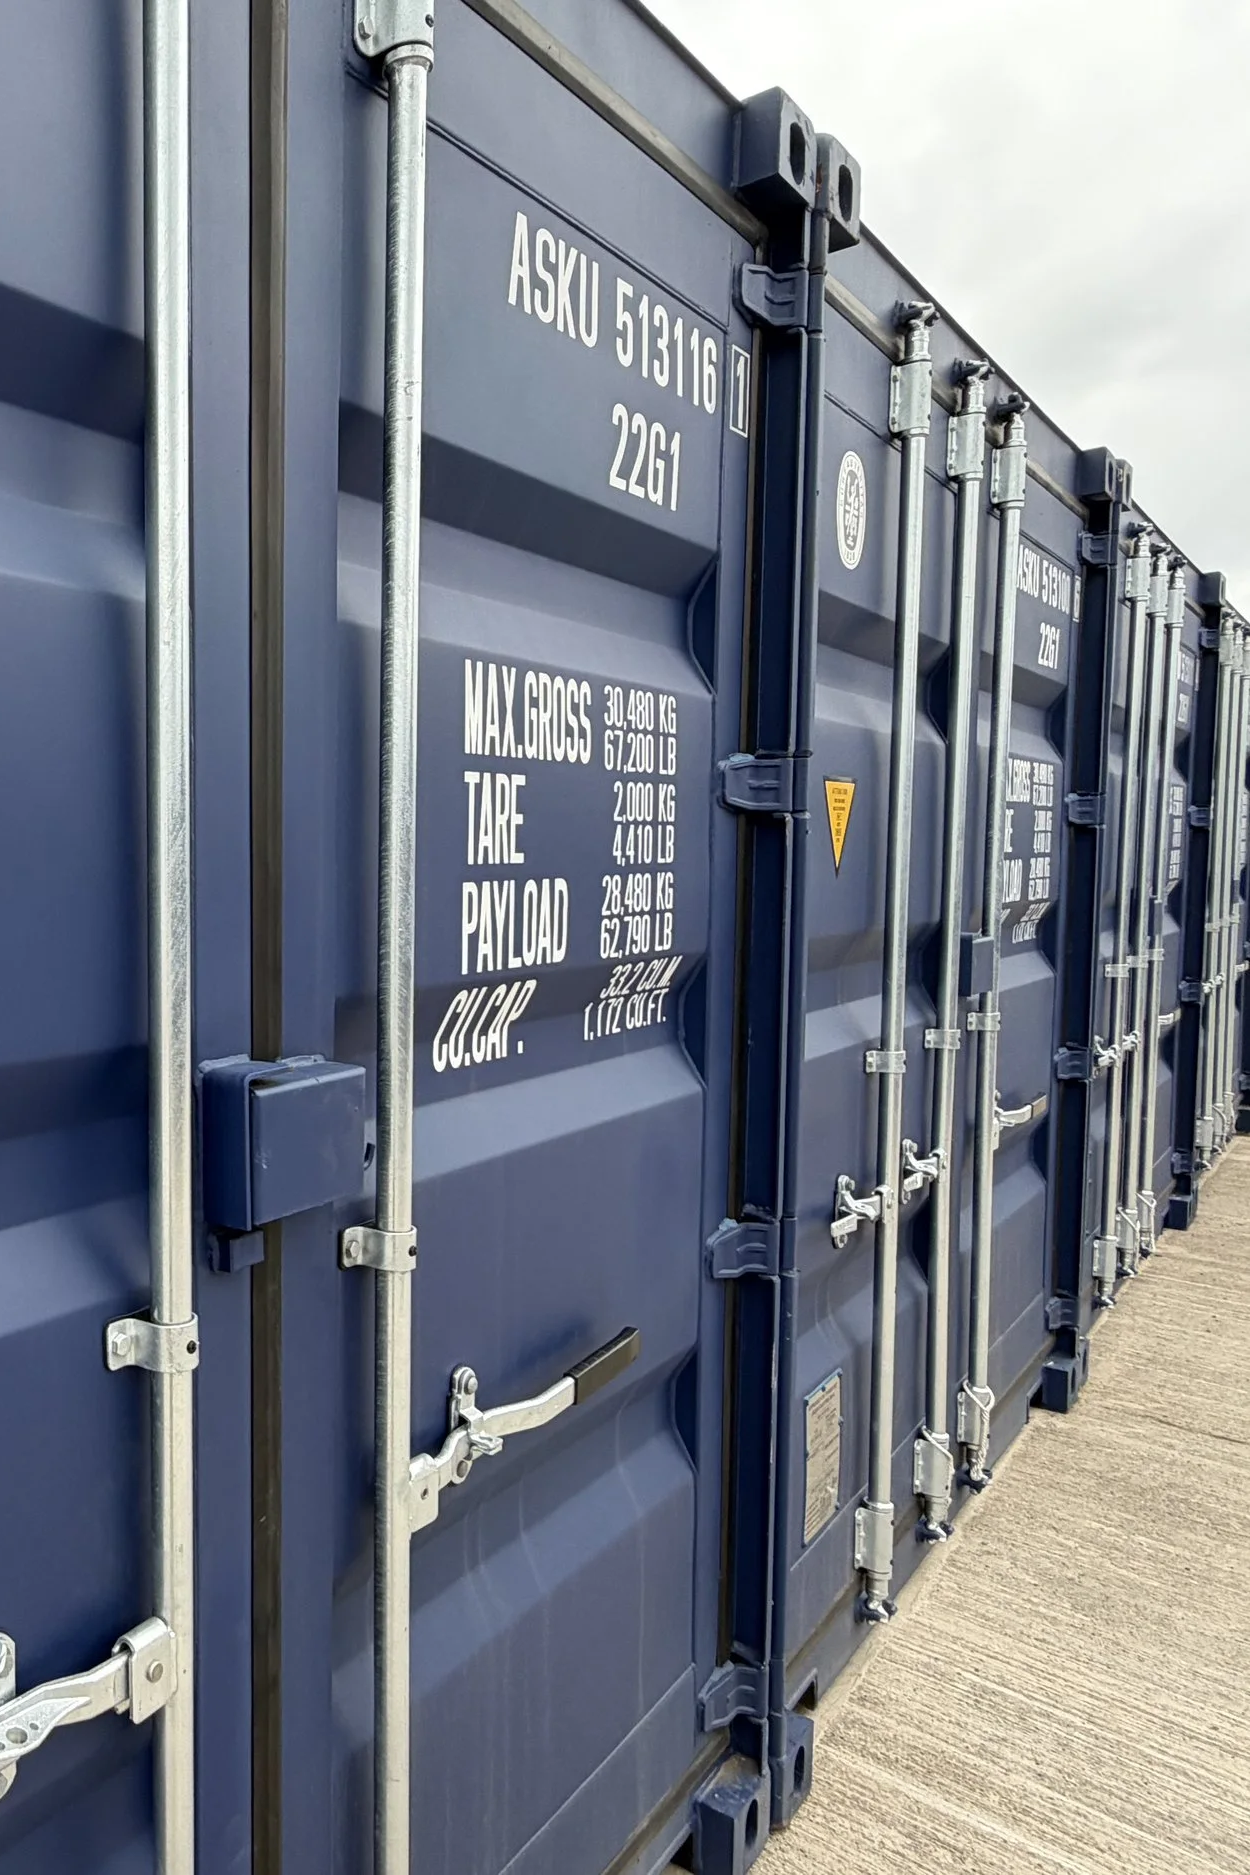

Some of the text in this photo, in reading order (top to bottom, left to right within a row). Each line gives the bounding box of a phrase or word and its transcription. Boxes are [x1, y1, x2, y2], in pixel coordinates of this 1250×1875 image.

[508, 211, 599, 348] ASKU
[616, 277, 717, 414] 513116
[610, 403, 681, 512] 22G1
[1017, 544, 1040, 598] ASKU
[464, 658, 592, 764] MAX.GROSS
[603, 685, 676, 734] 30,480 KG
[604, 728, 677, 776] 67,200 LB
[464, 771, 526, 864] TARE
[613, 780, 676, 823] 2,000 KG
[612, 824, 675, 867] 4,410 LB
[601, 872, 674, 917] 28,480 KG
[461, 878, 569, 975] PAYLOAD
[600, 912, 672, 959] 62,790 LB
[599, 955, 683, 999] 33.2 CU.M.
[433, 980, 537, 1073] CU.CAP.
[583, 987, 670, 1041] 1,172 CU.FT.
